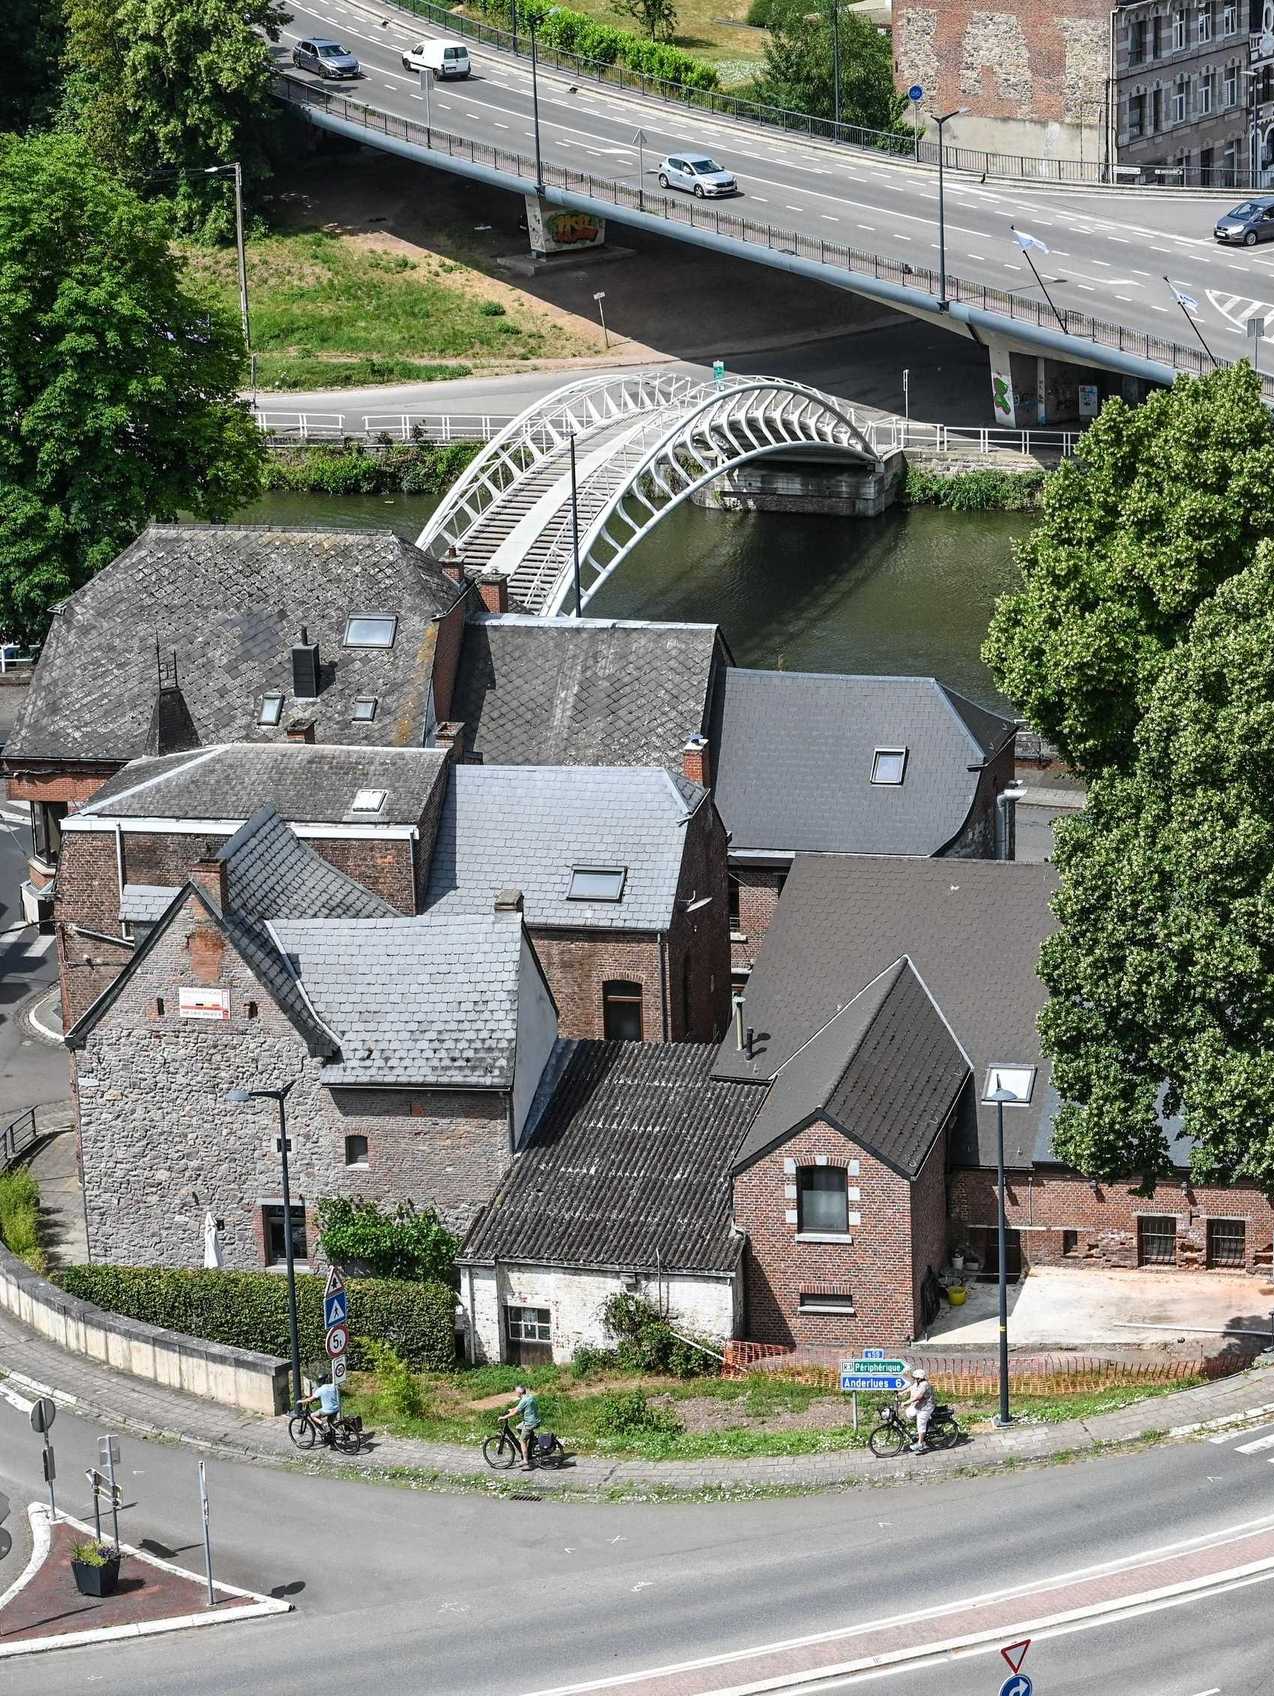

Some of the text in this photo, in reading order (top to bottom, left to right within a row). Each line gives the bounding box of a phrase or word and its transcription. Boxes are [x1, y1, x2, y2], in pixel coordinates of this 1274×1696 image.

[855, 1362, 900, 1373] Périphérique
[845, 1378, 902, 1387] Anderlues 6
